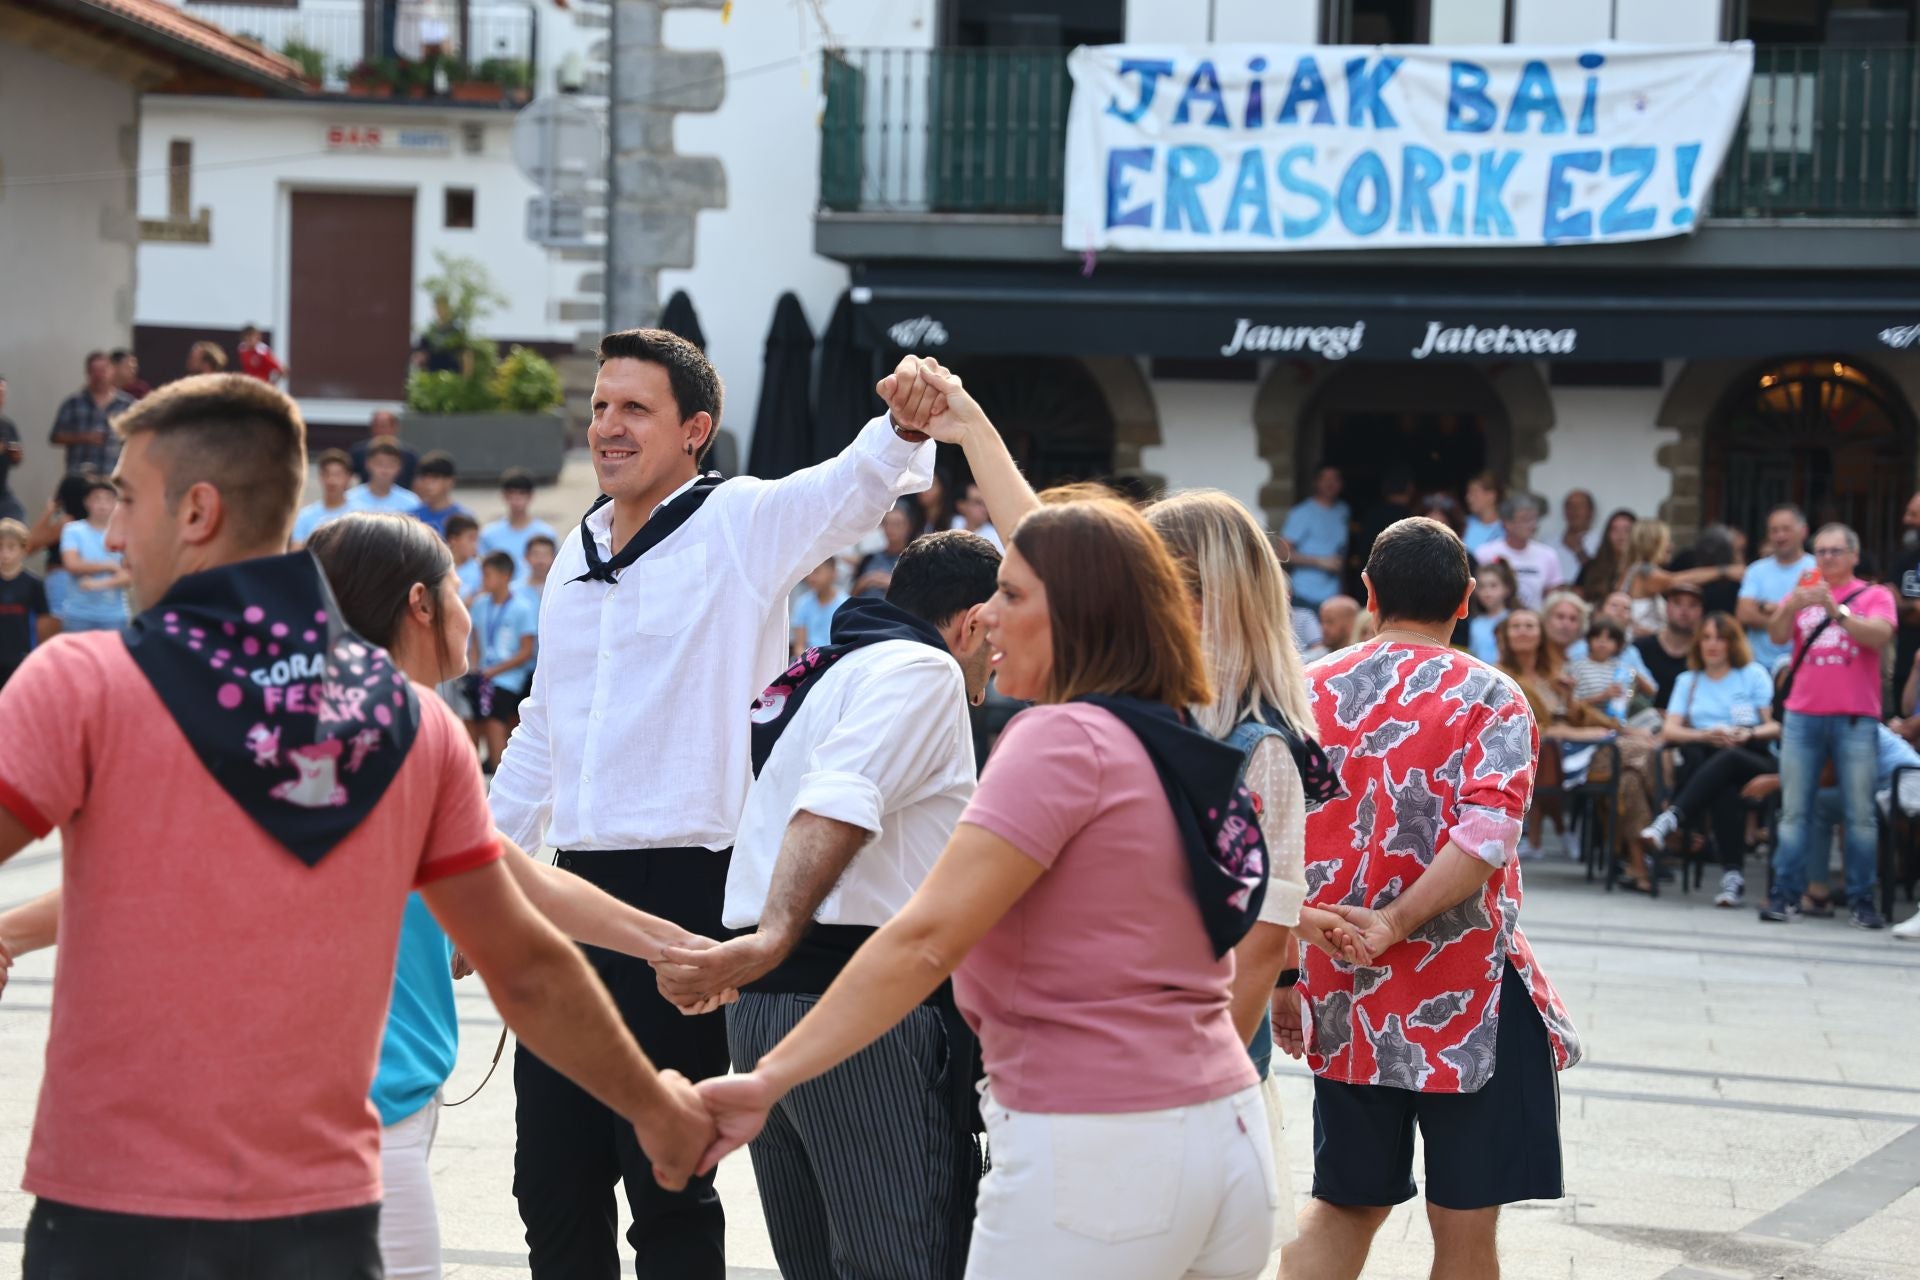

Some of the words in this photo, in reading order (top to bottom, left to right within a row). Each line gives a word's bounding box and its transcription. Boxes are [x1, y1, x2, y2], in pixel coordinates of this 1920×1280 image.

[327, 125, 382, 146] BAR
[1542, 142, 1702, 244] EZ!
[1221, 318, 1365, 359] Jauregi
[1411, 321, 1577, 359] Jatetxea
